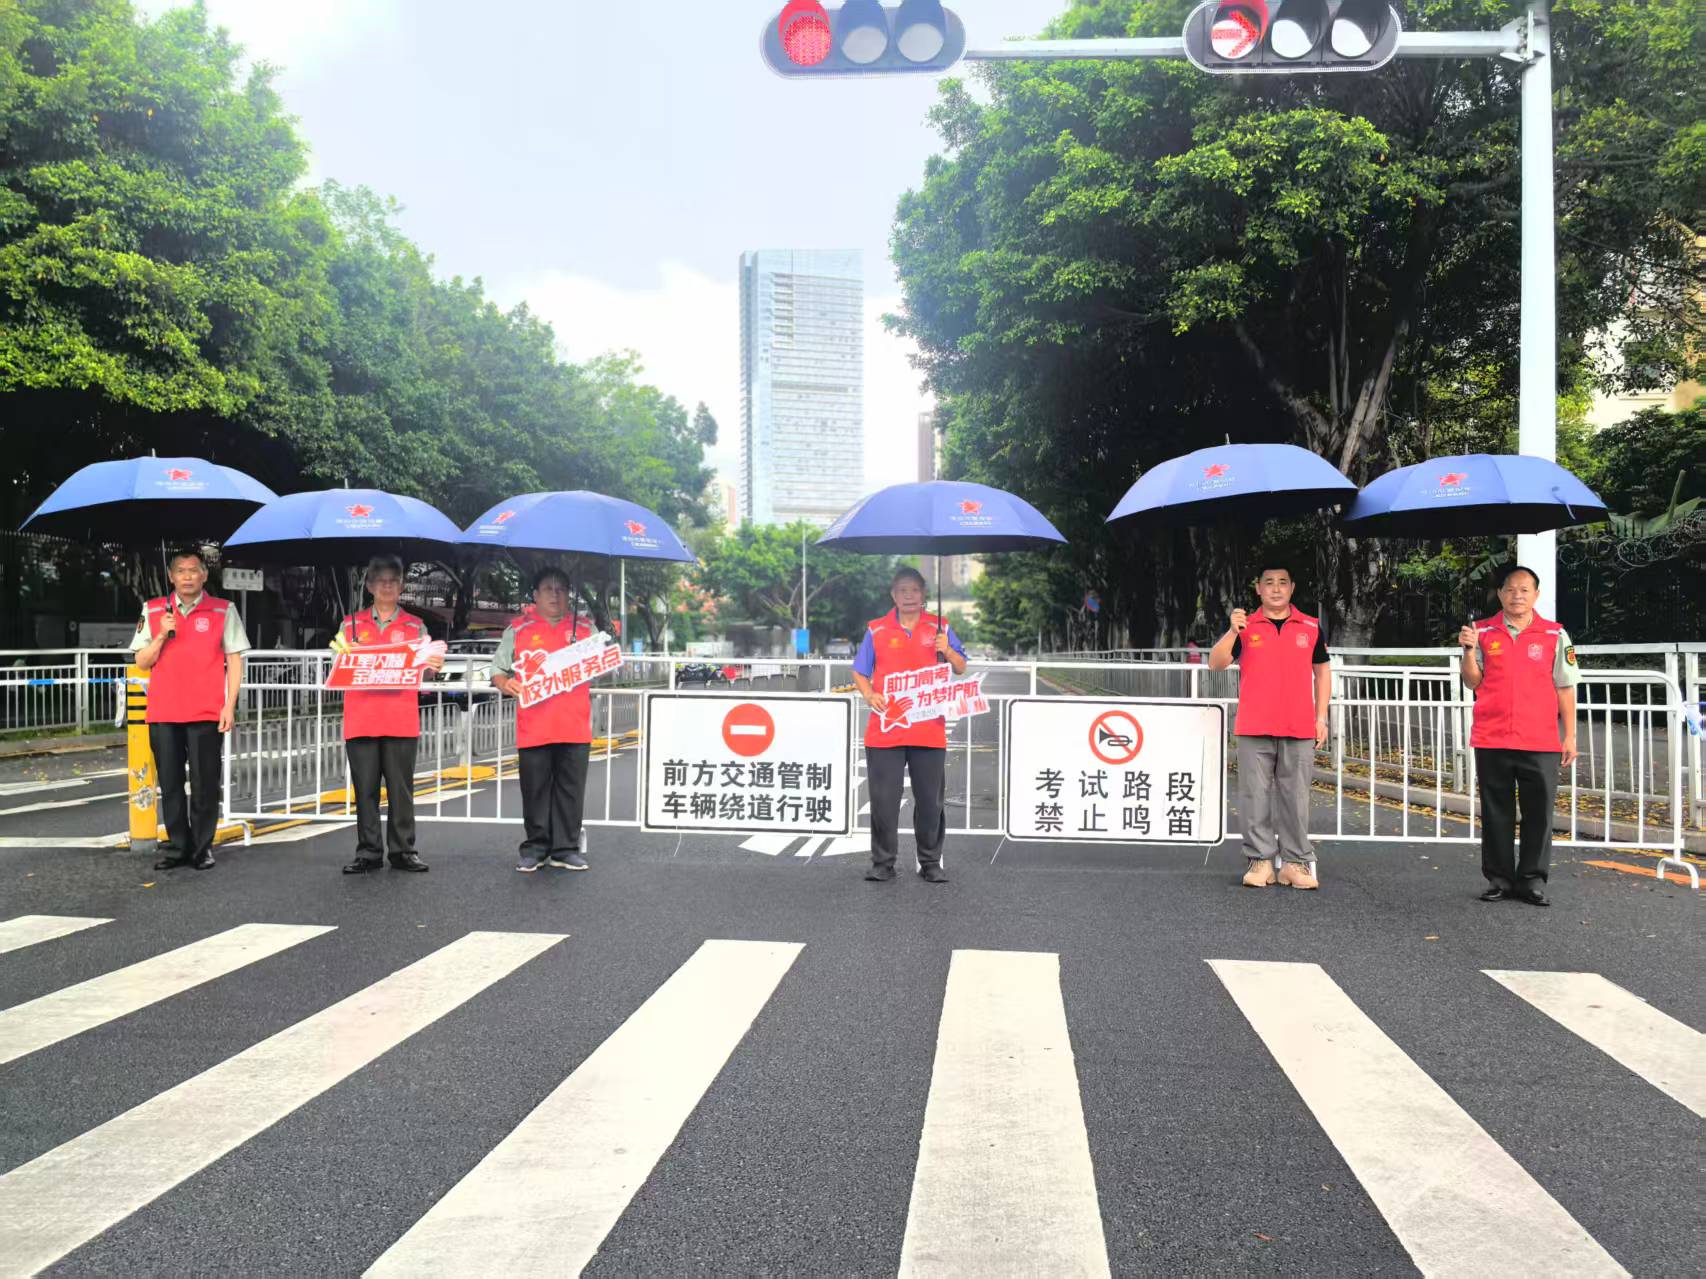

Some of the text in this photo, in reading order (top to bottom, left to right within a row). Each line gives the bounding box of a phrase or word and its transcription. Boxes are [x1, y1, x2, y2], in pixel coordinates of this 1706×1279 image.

[524, 645, 621, 705] 校外服务点
[886, 666, 950, 693] 助力高考
[917, 680, 979, 707] 为梦护航
[662, 759, 832, 791] 前方交通管制
[1035, 768, 1195, 802] 考试路段
[661, 791, 832, 823] 车辆绕道行驶
[1034, 802, 1195, 836] 禁止鸣笛
